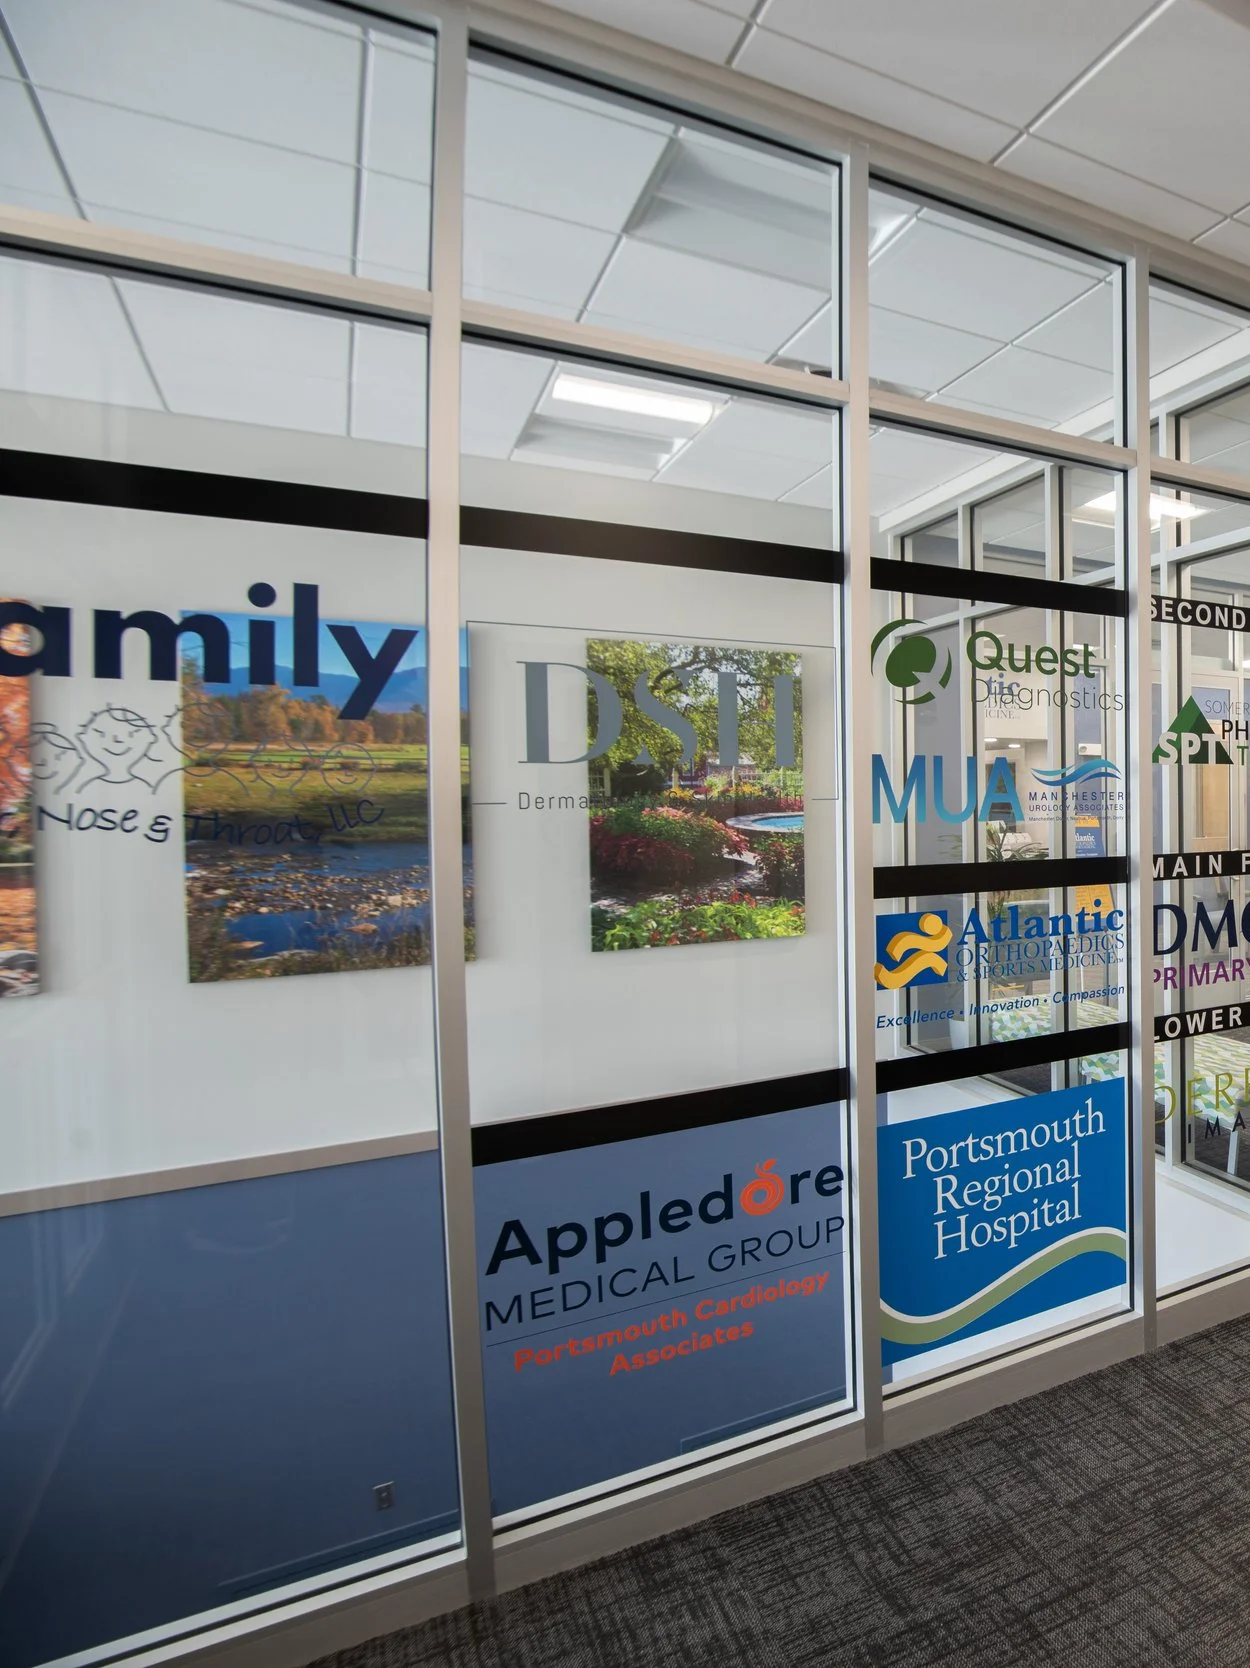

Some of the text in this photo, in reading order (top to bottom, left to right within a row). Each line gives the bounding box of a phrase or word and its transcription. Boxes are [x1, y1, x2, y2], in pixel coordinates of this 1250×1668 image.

[1150, 597, 1246, 630] SECOND
[966, 631, 1097, 679] Quest
[970, 678, 1124, 711] Diagnostics
[1158, 732, 1222, 765] SPT
[871, 753, 1025, 824] MUA
[1028, 791, 1124, 801] MANCHESTER
[1028, 803, 1124, 812] UROLOGY ASSOCIATES
[37, 803, 139, 834] Nose
[143, 814, 173, 843] &
[326, 799, 385, 833] LLC
[1152, 854, 1223, 879] MAIN
[957, 898, 1125, 945] Atlantic
[955, 933, 1125, 967] ORTHOPAEDICS
[956, 971, 969, 982] &
[973, 961, 1037, 980] SPORTS
[876, 984, 1125, 1029] Excellence Innovation Compassion
[902, 1097, 1106, 1179] Portsmouth
[933, 1140, 1082, 1216] Regional
[485, 1159, 844, 1275] Appledore
[934, 1181, 1083, 1260] Hospital
[485, 1216, 845, 1331] MEDICAL GROUP
[514, 1271, 831, 1373] Portsmouth Cardiology
[609, 1320, 755, 1376] Associates
